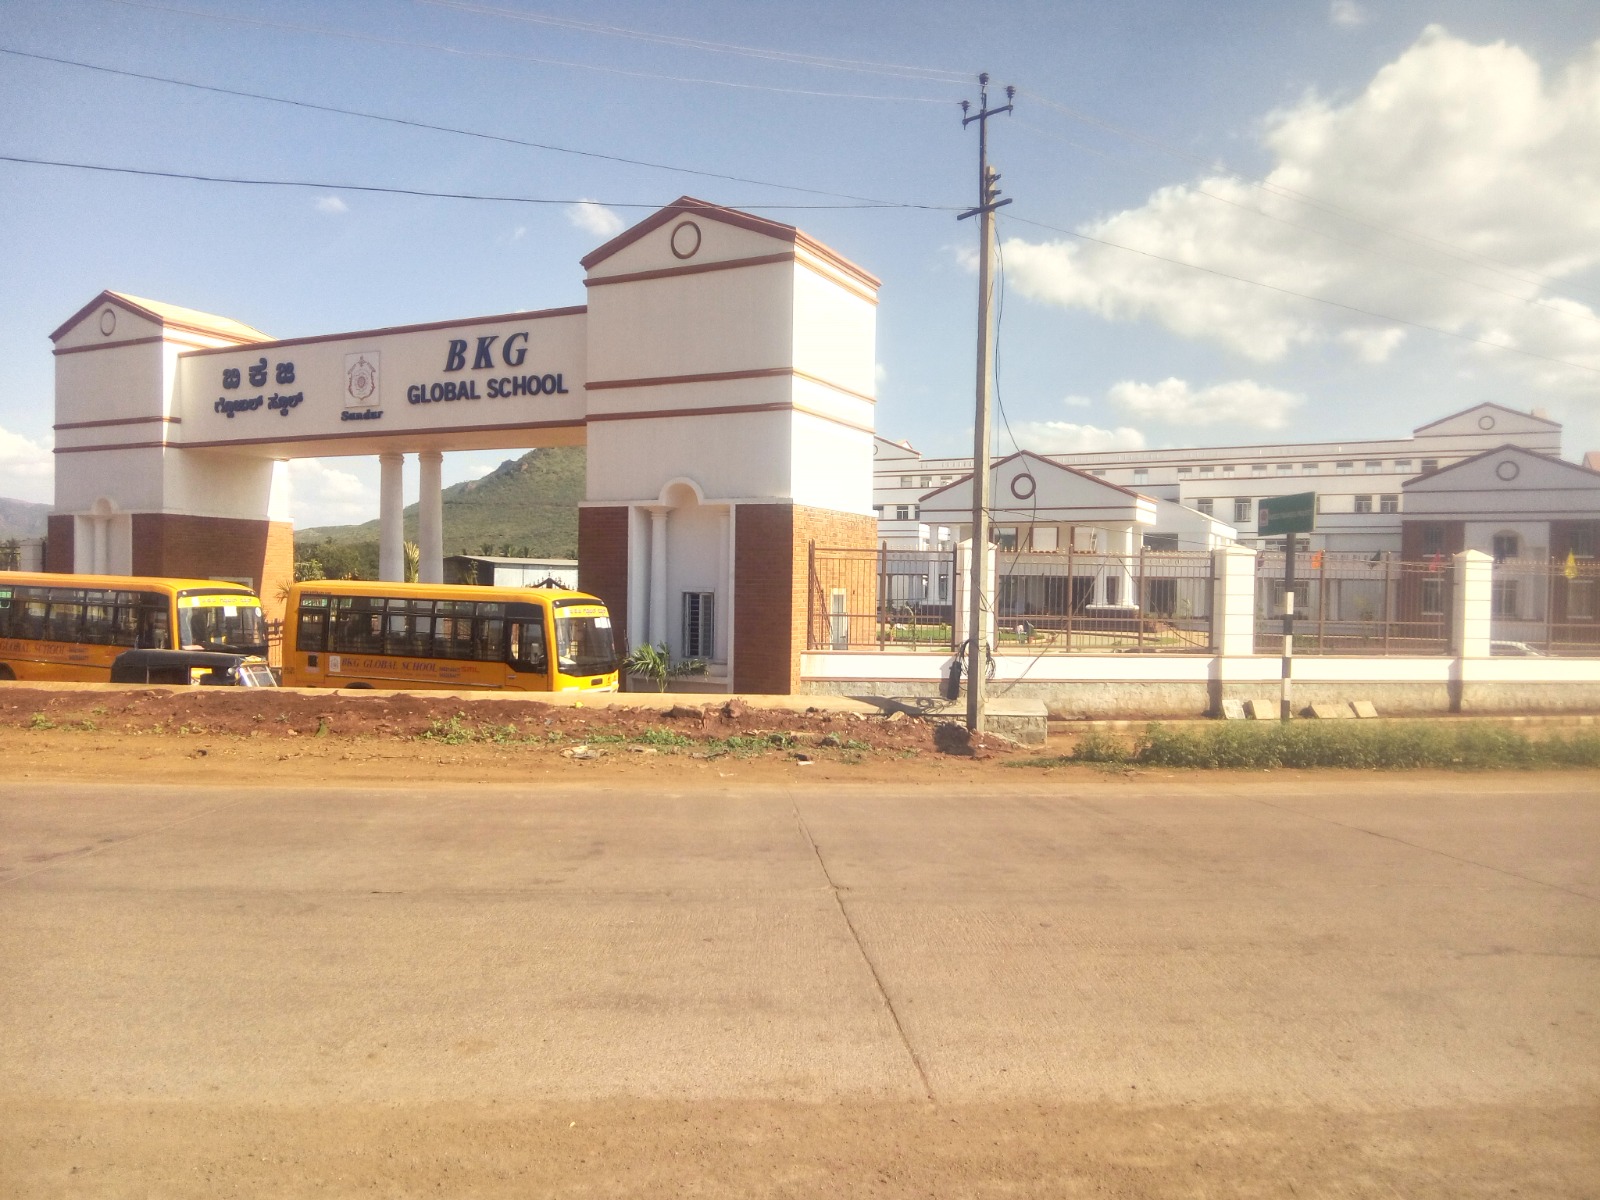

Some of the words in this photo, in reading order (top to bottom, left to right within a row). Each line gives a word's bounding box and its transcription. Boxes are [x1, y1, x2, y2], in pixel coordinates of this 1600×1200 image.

[443, 332, 529, 372] BKG
[407, 380, 481, 404] GLOBAL
[487, 373, 568, 398] SCHOOL
[363, 659, 398, 670] GLOBAL
[401, 661, 437, 673] SCHOOL
